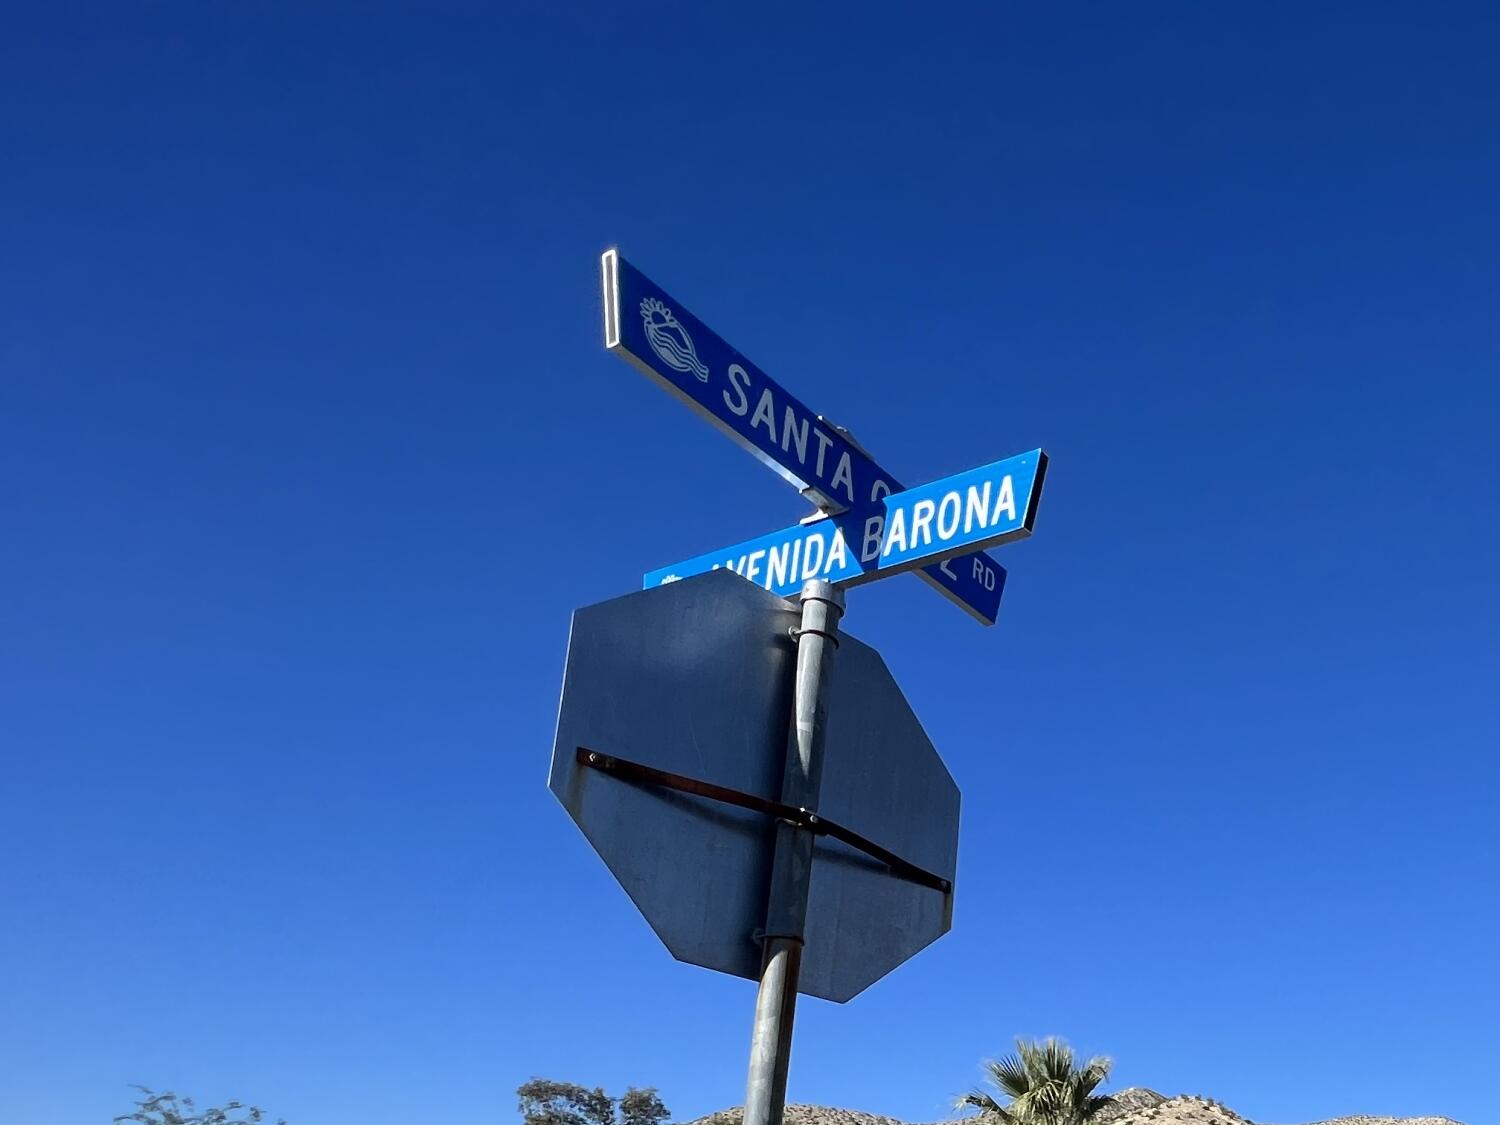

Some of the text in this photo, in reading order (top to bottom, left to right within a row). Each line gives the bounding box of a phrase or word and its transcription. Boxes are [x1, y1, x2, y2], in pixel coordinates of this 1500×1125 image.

[712, 475, 1016, 591] ENIDA BARONA
[723, 363, 996, 592] SANTA RD
